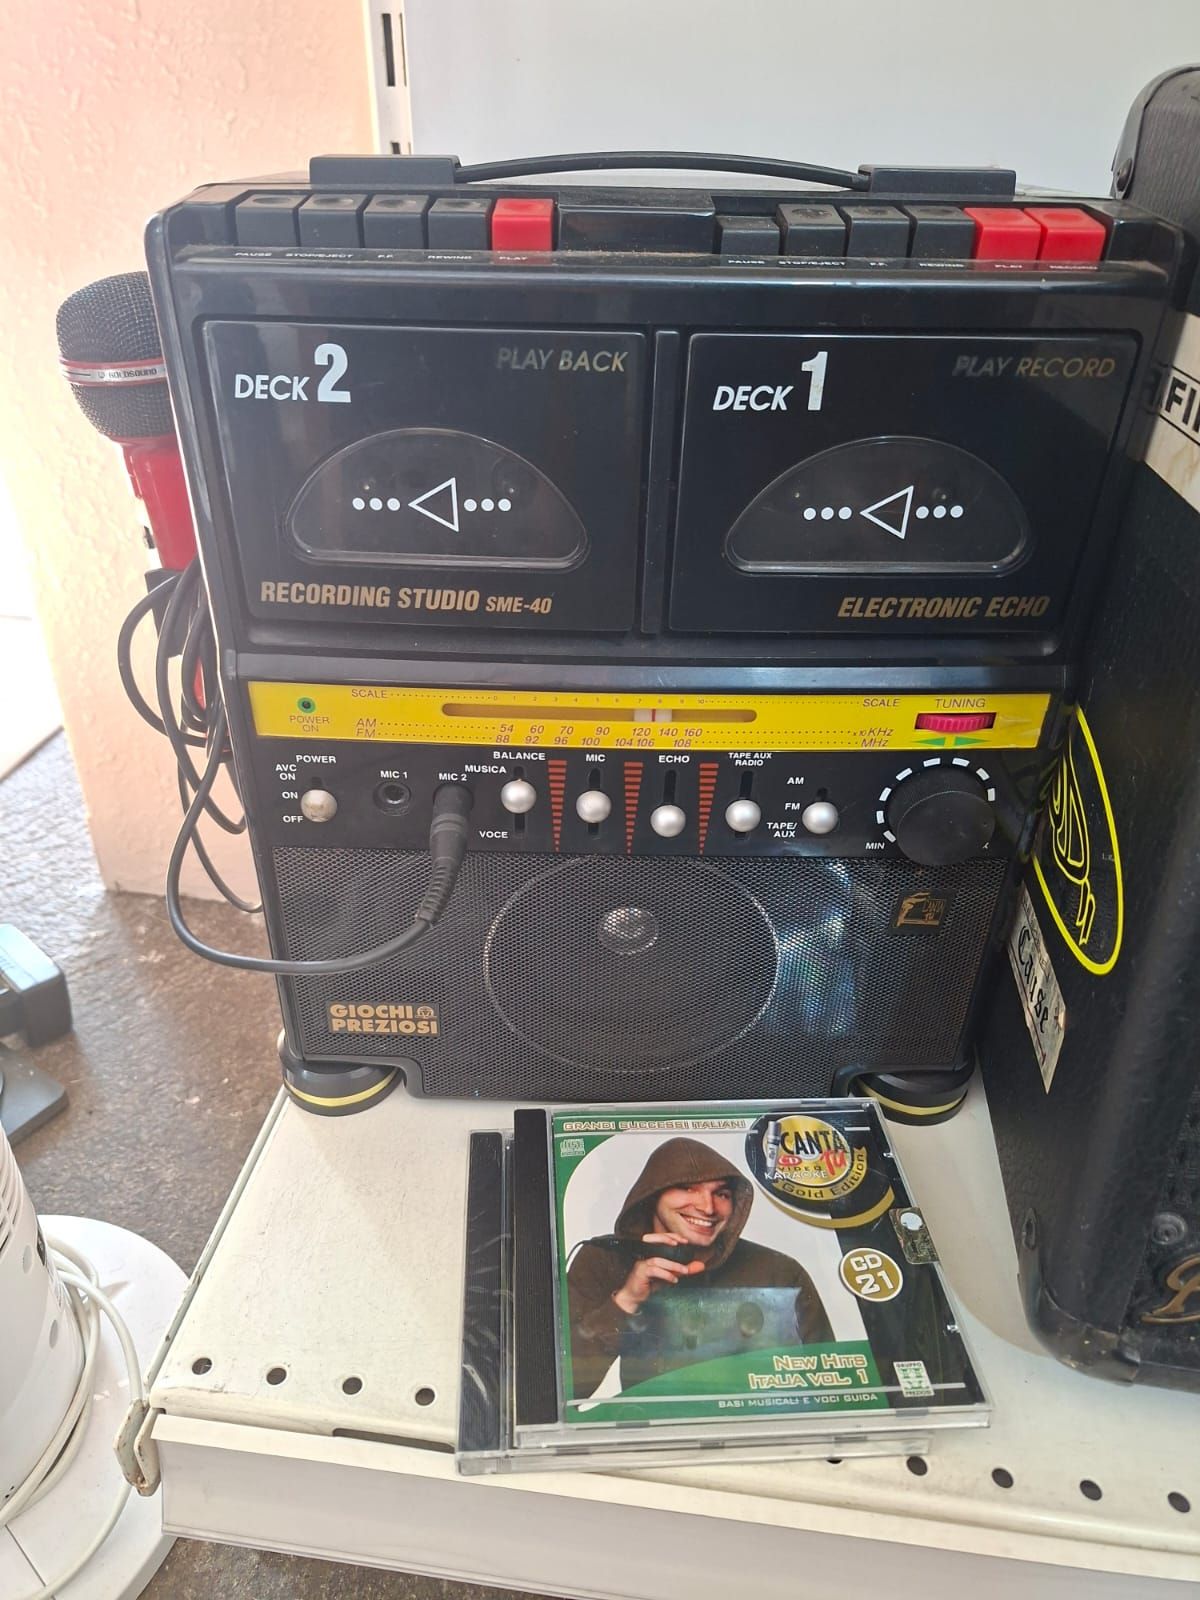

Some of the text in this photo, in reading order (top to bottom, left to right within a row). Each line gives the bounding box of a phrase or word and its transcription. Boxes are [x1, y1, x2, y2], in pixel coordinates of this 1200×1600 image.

[496, 347, 628, 373] PLAY BACK
[952, 355, 1116, 379] PLAY RECORD
[234, 343, 352, 403] DECK 2
[712, 351, 829, 412] DECK 1
[1163, 376, 1200, 436] FI
[260, 581, 554, 615] RECORDING STUDIO SME-40
[837, 595, 1051, 618] ELECTRONIC ECHO
[351, 688, 388, 699] SCALE
[862, 698, 901, 707] SCALE
[934, 698, 987, 709] TUNING
[289, 715, 330, 725] POWER
[302, 724, 320, 733] ON
[356, 718, 377, 728] AM
[500, 724, 514, 733] 54
[530, 725, 545, 734] 60
[560, 726, 574, 735] 70
[595, 726, 611, 736] 90
[632, 728, 651, 737] 120
[659, 728, 678, 737] 140
[684, 728, 703, 737] 160
[355, 728, 889, 748] FM 88 92 96 100 104 106 108 MHz
[295, 754, 337, 764] POWER
[493, 750, 546, 761] BALANCE
[585, 754, 606, 763] MIC
[658, 754, 690, 764] ECHO
[728, 752, 772, 760] TAPE AUX
[275, 763, 297, 772] AVC
[735, 759, 764, 767] RADIO
[380, 769, 408, 780] MIC 1
[464, 763, 507, 775] MUSICA
[279, 772, 296, 781] ON
[438, 772, 468, 783] MIC 2
[787, 776, 804, 785] AM
[281, 790, 299, 800] ON
[785, 802, 801, 811] FM
[282, 814, 304, 824] OFF
[767, 821, 798, 831] TAPE/
[479, 829, 509, 839] VOCE
[773, 830, 797, 839] AUX
[865, 841, 886, 851] MIN
[329, 1003, 414, 1019] GIOCHI
[331, 1018, 439, 1035] PREZIOSI
[562, 1118, 747, 1132] GRANDI SUCCESSI ITALIANI
[780, 1130, 848, 1155] CANTA
[778, 1155, 801, 1165] CD
[764, 1170, 828, 1180] KARAOKE
[781, 1153, 865, 1199] Gold Edition
[849, 1253, 883, 1272] CD
[855, 1270, 894, 1295] 21
[856, 1368, 869, 1384] 1
[718, 1393, 879, 1408] BASI MUSICALI E VOCI GUIDA
